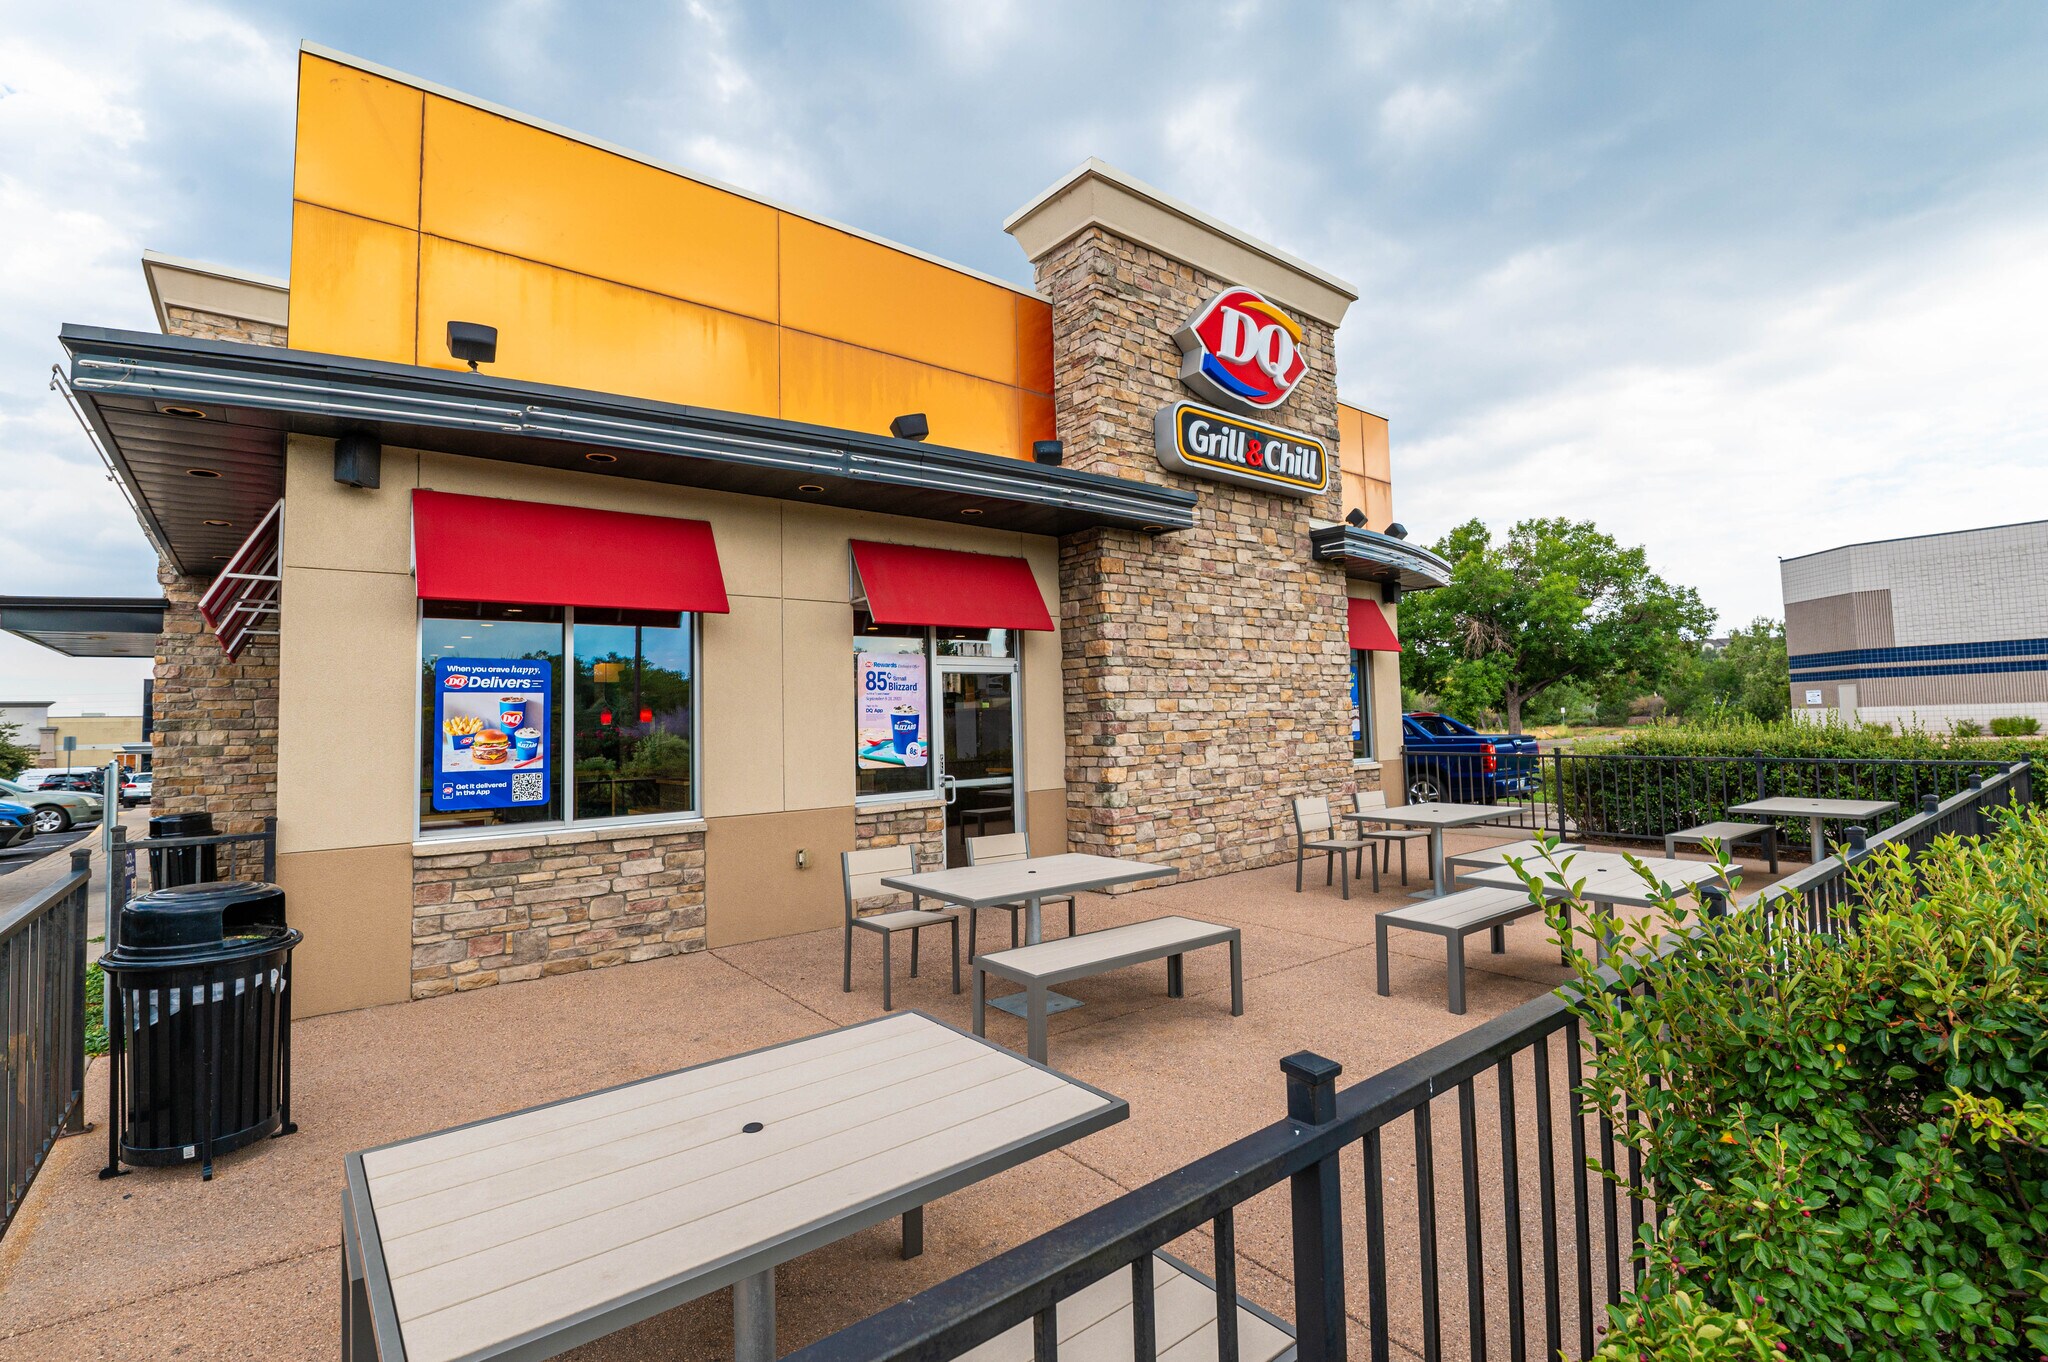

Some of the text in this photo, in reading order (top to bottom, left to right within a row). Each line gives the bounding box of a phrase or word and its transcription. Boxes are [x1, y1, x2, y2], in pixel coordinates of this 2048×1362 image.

[1216, 305, 1294, 390] DQ
[447, 665, 471, 673] When
[472, 666, 487, 674] you
[510, 665, 541, 675] happy.
[468, 676, 531, 689] Delivers
[888, 682, 918, 691] Blizzard
[502, 714, 521, 725] DQ
